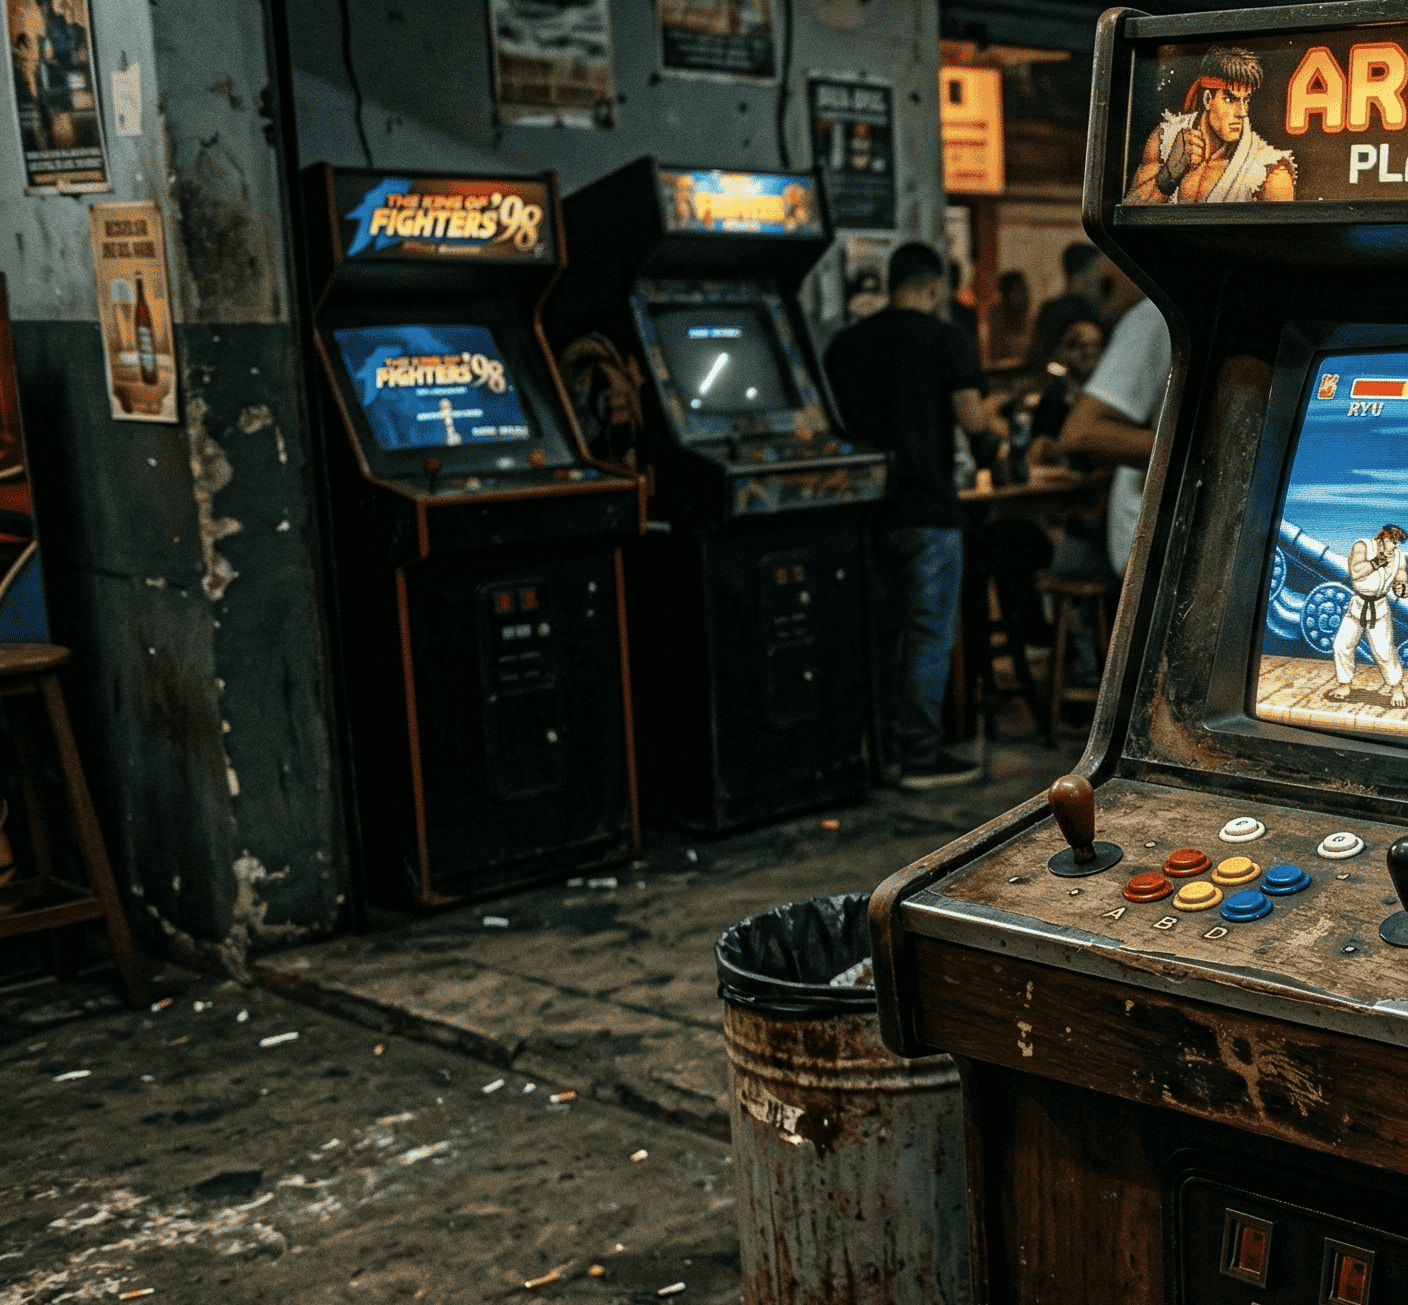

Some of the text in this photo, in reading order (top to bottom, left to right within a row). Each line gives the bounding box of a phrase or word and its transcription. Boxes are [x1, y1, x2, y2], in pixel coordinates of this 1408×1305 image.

[369, 207, 499, 239] FIGHTERS
[1347, 401, 1382, 417] RYU
[1103, 906, 1229, 939] A B D
